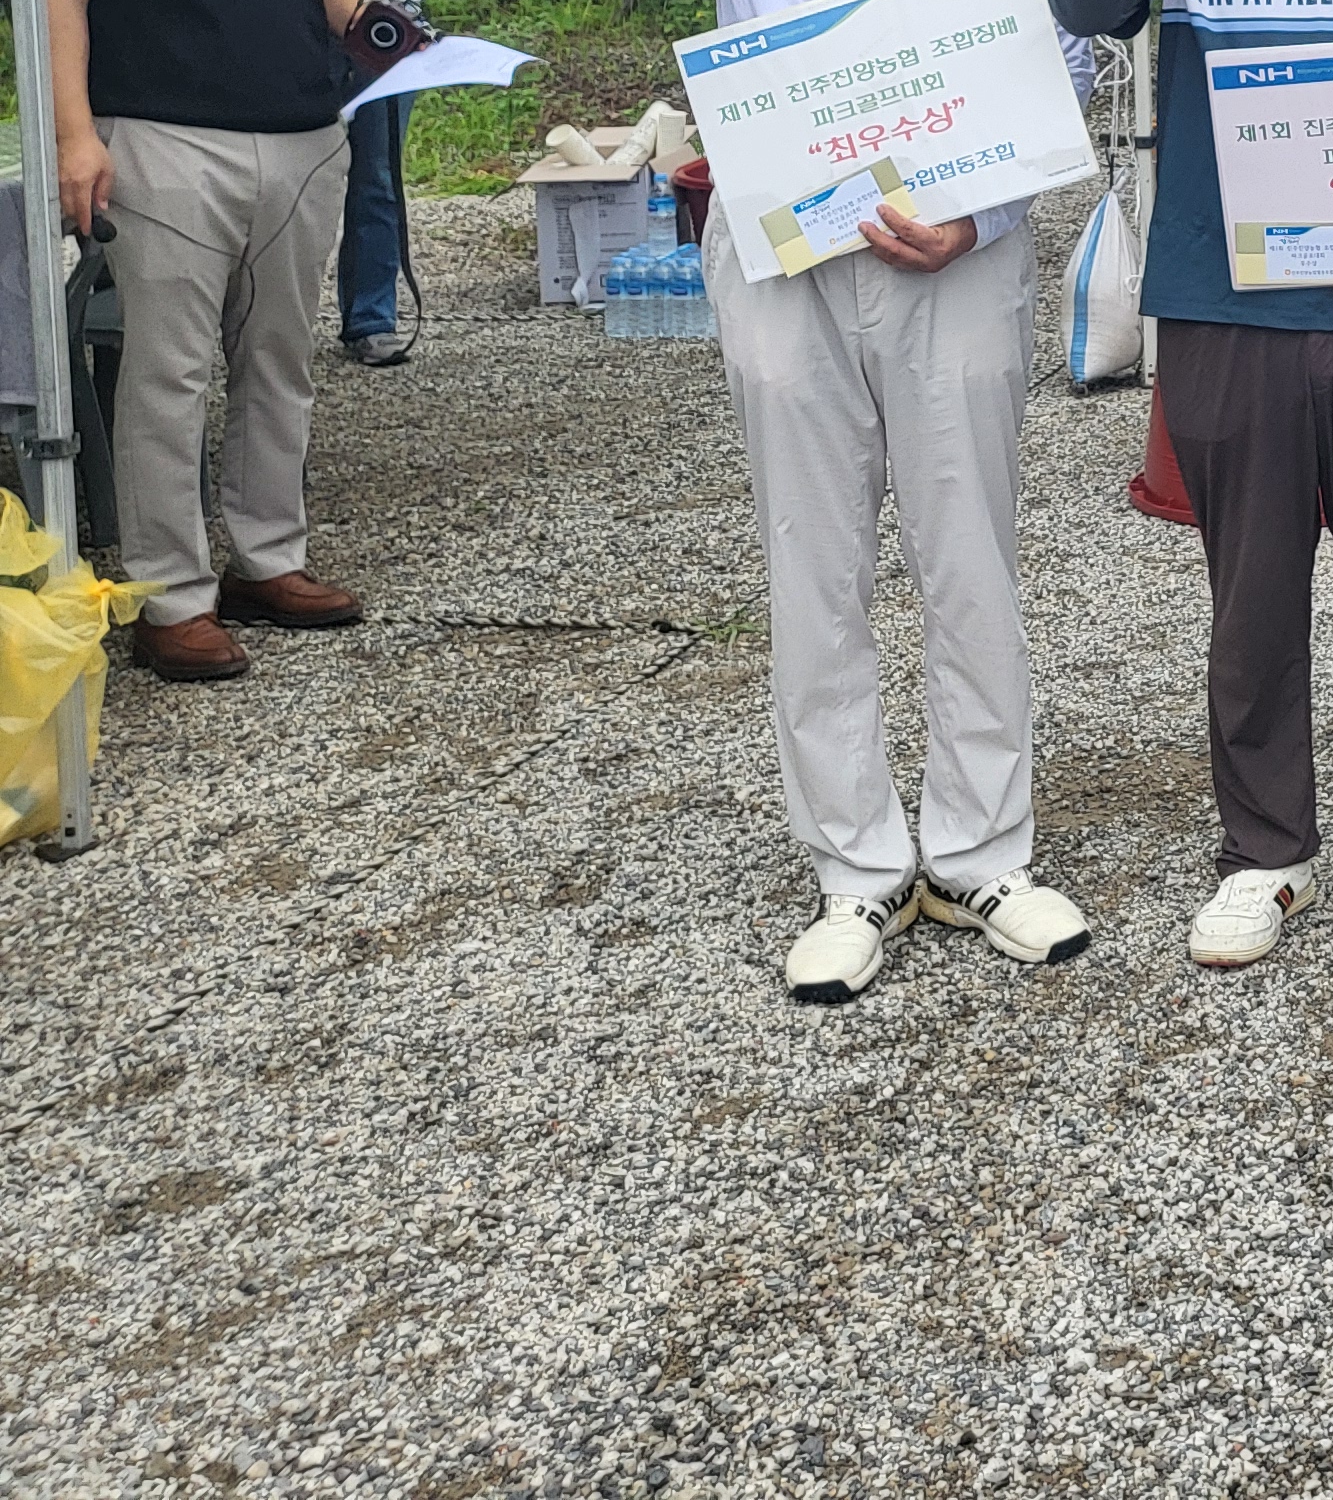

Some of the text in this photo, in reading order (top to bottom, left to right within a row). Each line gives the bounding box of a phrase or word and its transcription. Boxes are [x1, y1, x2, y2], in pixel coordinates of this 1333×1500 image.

[709, 35, 769, 66] NH
[716, 15, 1020, 126] 제1회 진주진양농협 조합장배
[1237, 65, 1295, 84] NH
[810, 70, 947, 128] 파크골프대회
[1236, 121, 1292, 144] 제1회
